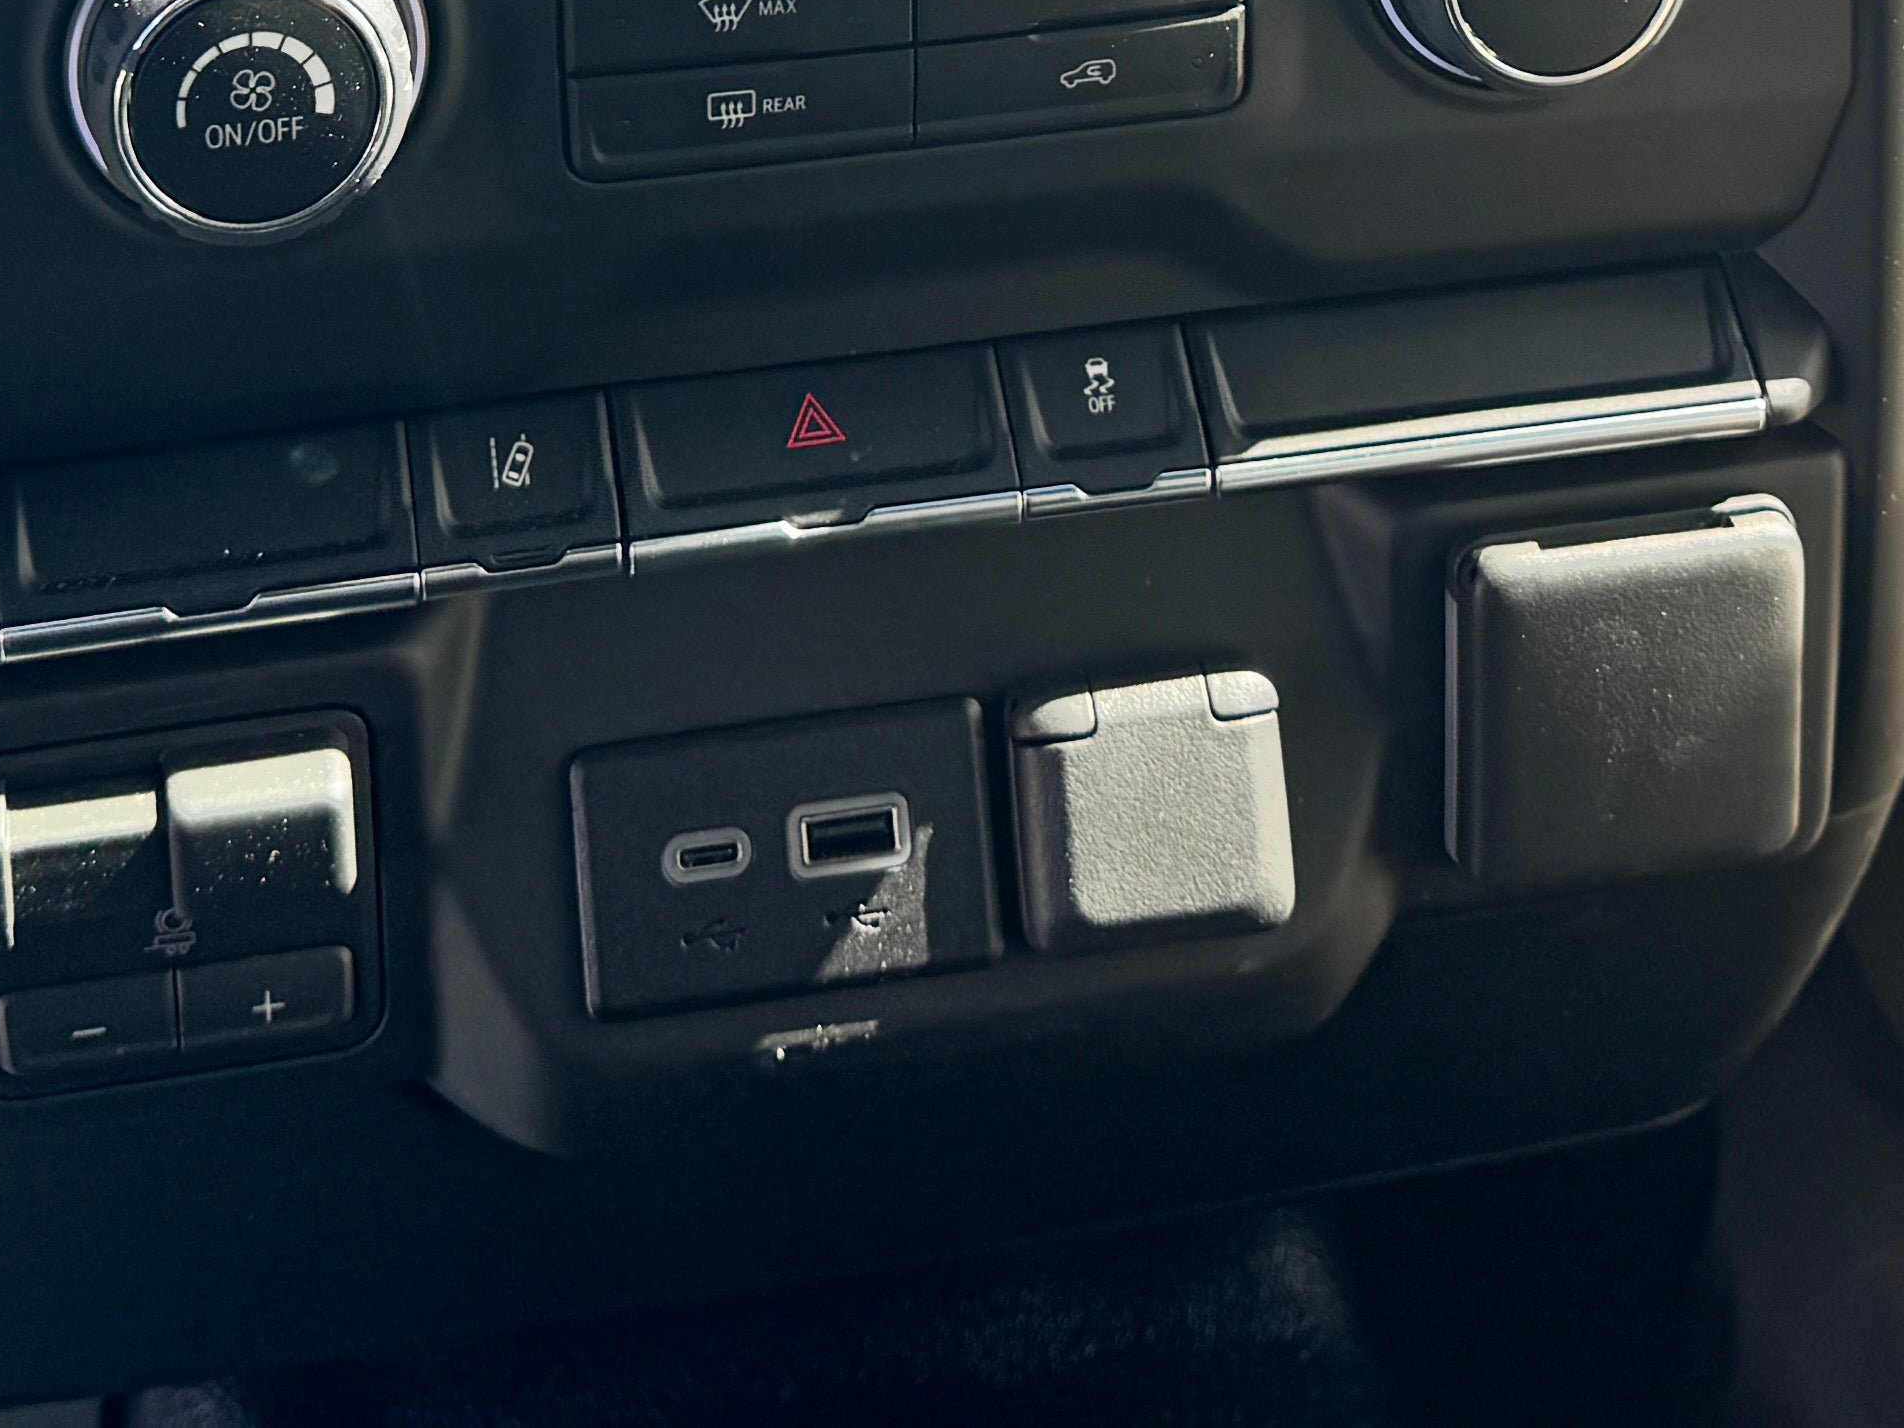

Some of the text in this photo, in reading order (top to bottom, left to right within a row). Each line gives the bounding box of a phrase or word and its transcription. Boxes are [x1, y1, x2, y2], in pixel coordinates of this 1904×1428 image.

[762, 94, 806, 114] REAR
[204, 115, 304, 149] ON/OFF
[1086, 395, 1116, 415] OFF
